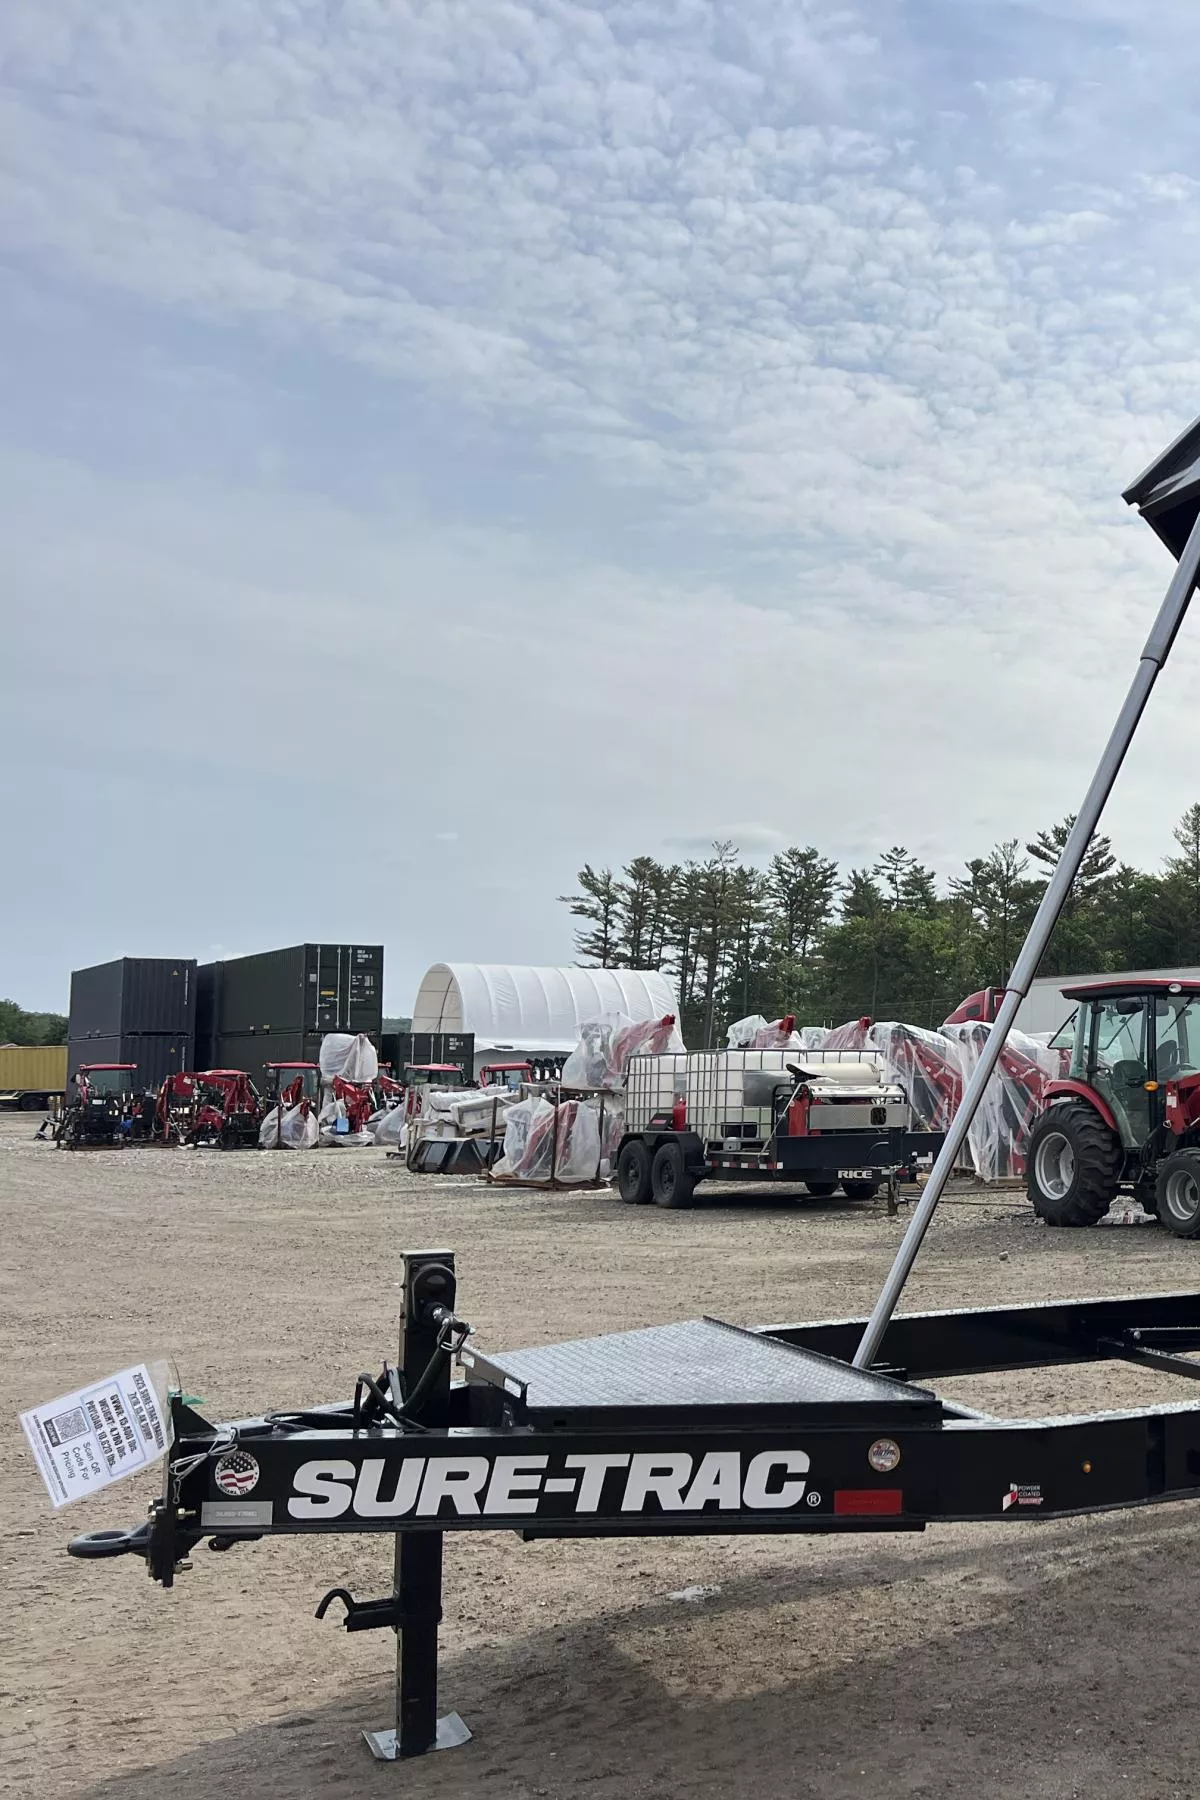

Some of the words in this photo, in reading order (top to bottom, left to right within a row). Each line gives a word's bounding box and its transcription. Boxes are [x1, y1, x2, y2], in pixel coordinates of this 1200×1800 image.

[837, 1170, 873, 1179] RICE
[139, 1389, 158, 1423] SURE-TRAC
[85, 1400, 103, 1431] PAYLOAD:
[106, 1453, 115, 1467] lbs.
[98, 1398, 115, 1427] WEIGHT:
[116, 1445, 126, 1459] lbs.
[110, 1394, 124, 1417] GVWR:
[127, 1439, 137, 1453] lbs.
[61, 1451, 76, 1478] Pricing
[72, 1446, 84, 1466] Code
[80, 1467, 89, 1480] For
[83, 1441, 94, 1461] Scan
[91, 1462, 100, 1474] QR
